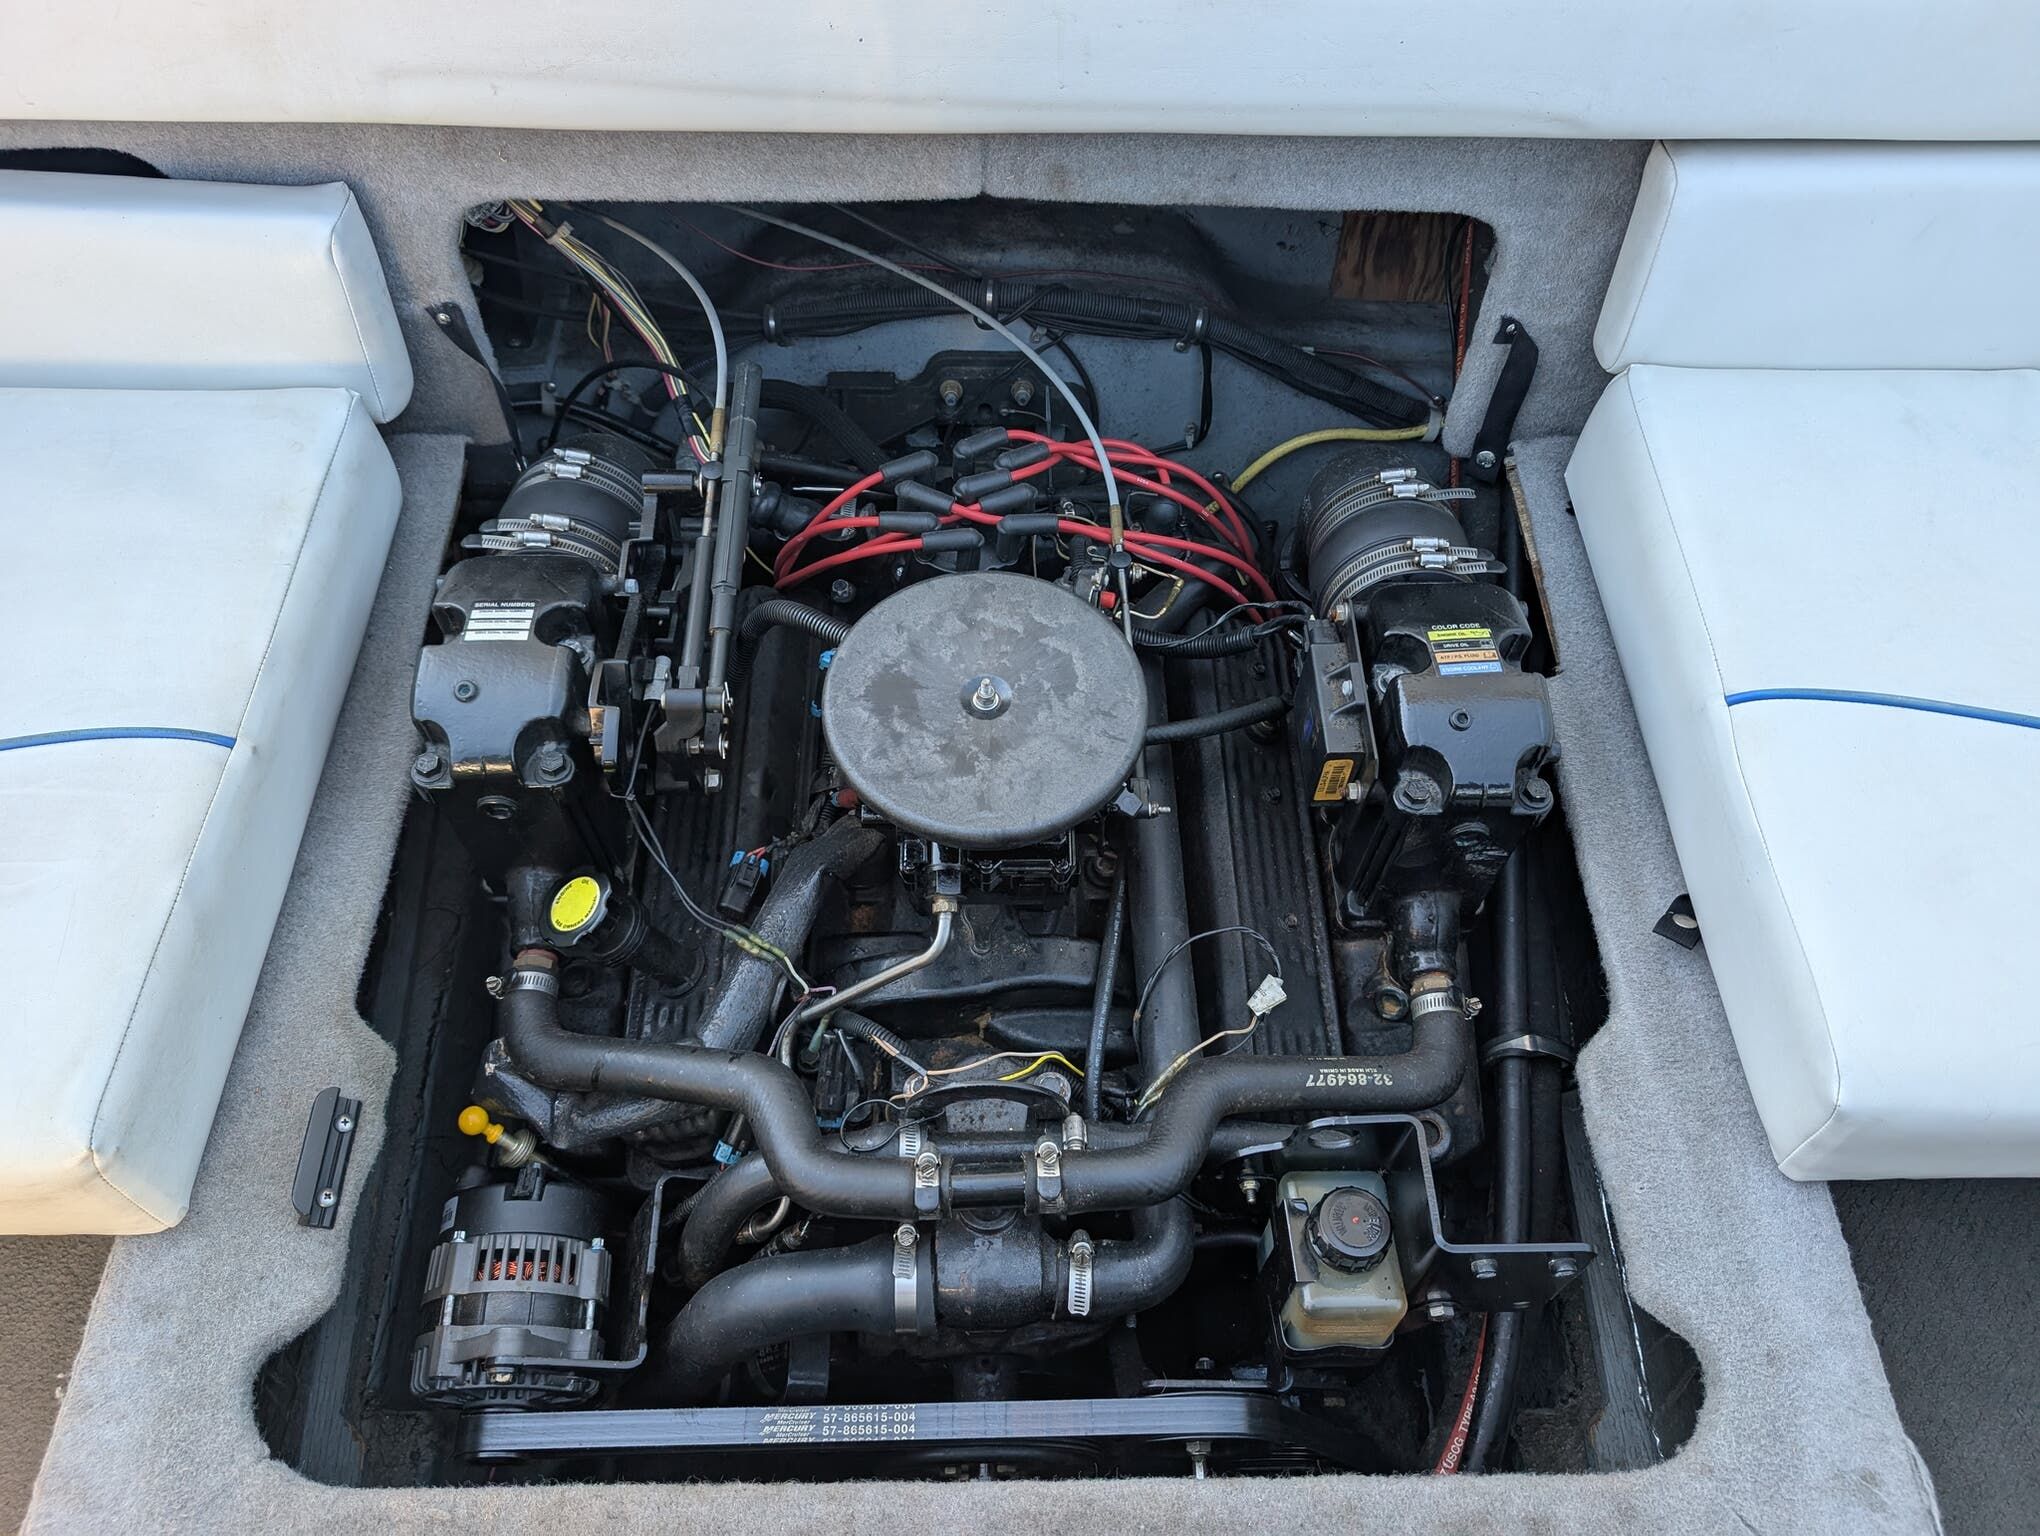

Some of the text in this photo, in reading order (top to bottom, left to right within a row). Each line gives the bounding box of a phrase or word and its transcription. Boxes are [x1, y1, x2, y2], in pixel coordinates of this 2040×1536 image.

[1305, 1073, 1393, 1087] 32-864977
[761, 1412, 916, 1424] MERCURY 57-865615-004
[760, 1424, 916, 1436] MERCURY 57-865615-004
